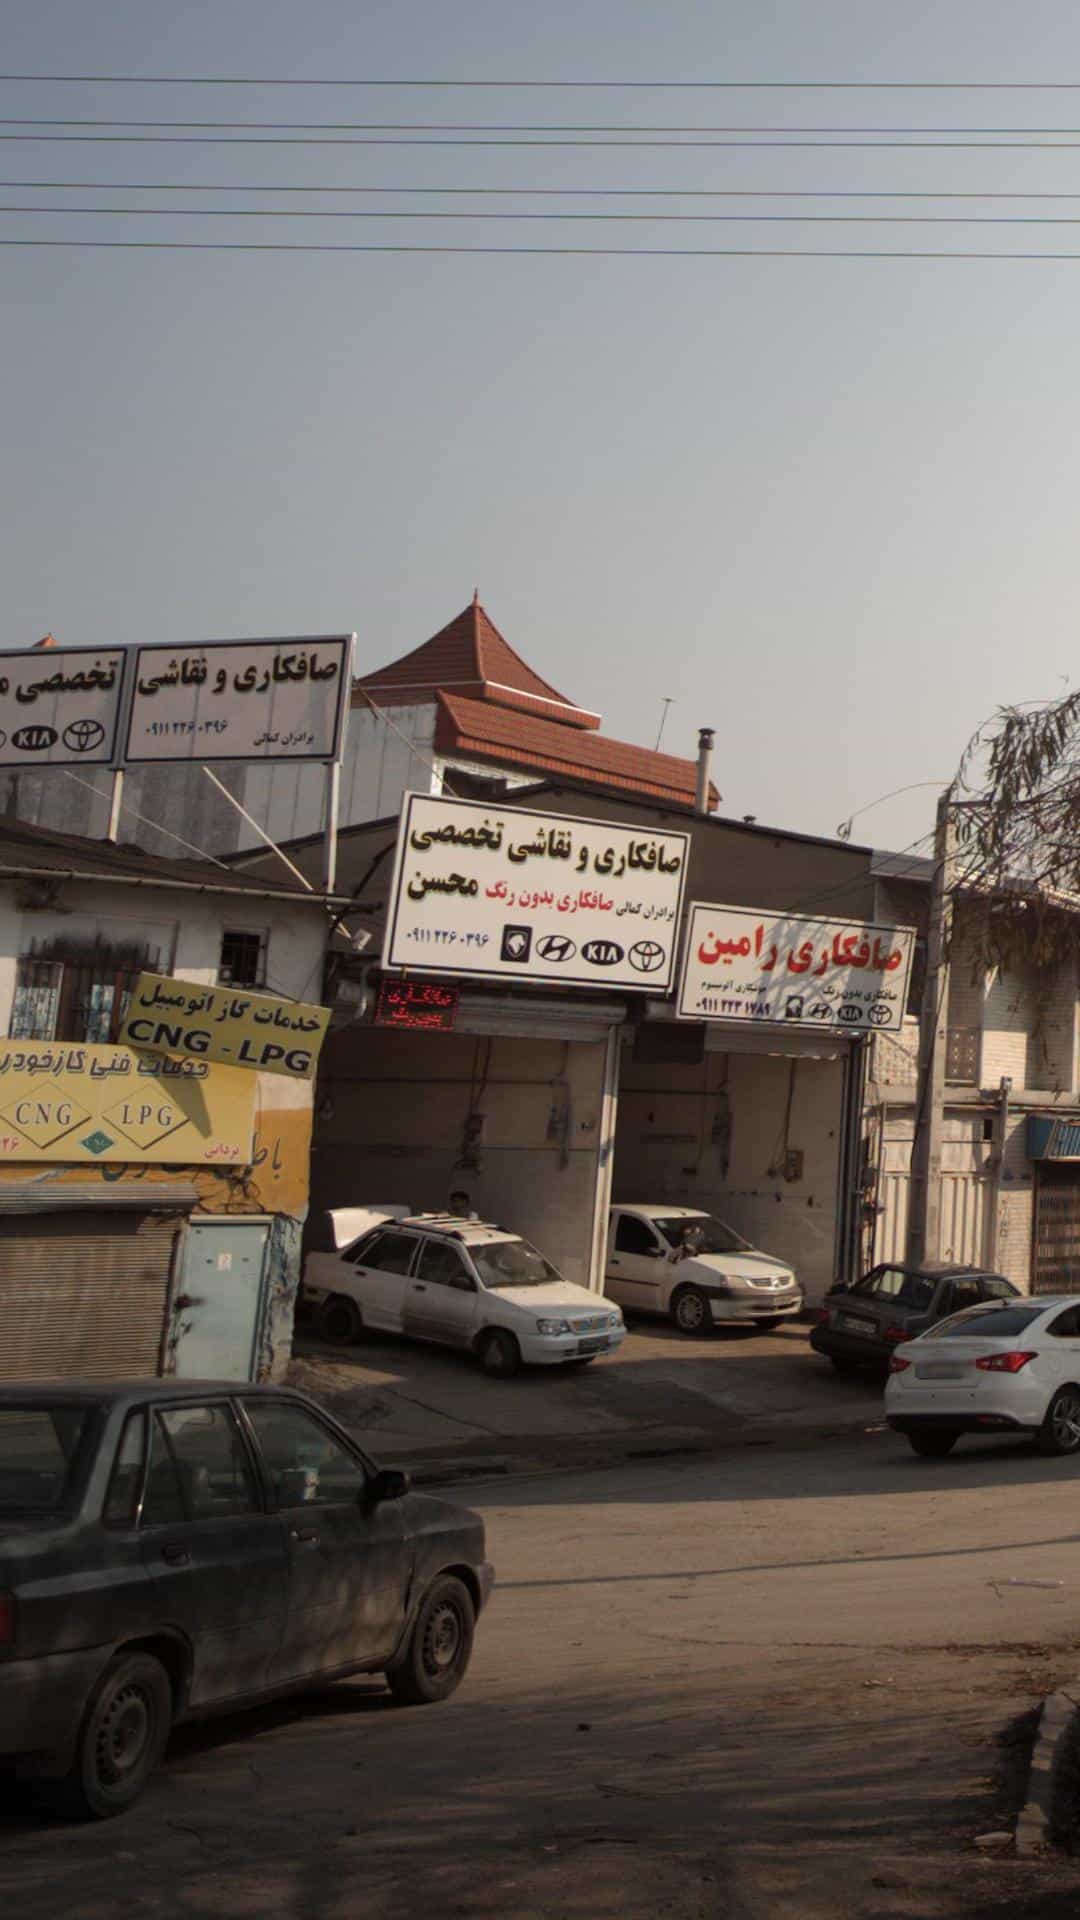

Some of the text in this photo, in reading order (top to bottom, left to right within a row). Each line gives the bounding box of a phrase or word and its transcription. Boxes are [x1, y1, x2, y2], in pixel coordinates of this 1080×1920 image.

[16, 660, 118, 704] تخصصی
[137, 658, 208, 696] نقاشی
[212, 672, 227, 694] و
[234, 652, 338, 693] صافکاری
[18, 729, 50, 747] KIA
[410, 819, 680, 877] صافکاری و نقاشی تخصصی
[407, 870, 478, 900] محسن
[518, 889, 554, 910] بدون
[556, 889, 614, 913] صافکاری
[588, 945, 616, 962] KIA
[697, 924, 903, 976] صافکاری رامین
[139, 983, 213, 1016] اتومبیل
[253, 1004, 320, 1033] خدمات
[127, 1019, 213, 1053] CNG
[238, 1039, 313, 1073] LPG
[90, 1052, 131, 1078] فنی
[137, 1052, 210, 1078] خدمات
[16, 1102, 72, 1126] CNG
[121, 1104, 173, 1127] LPG
